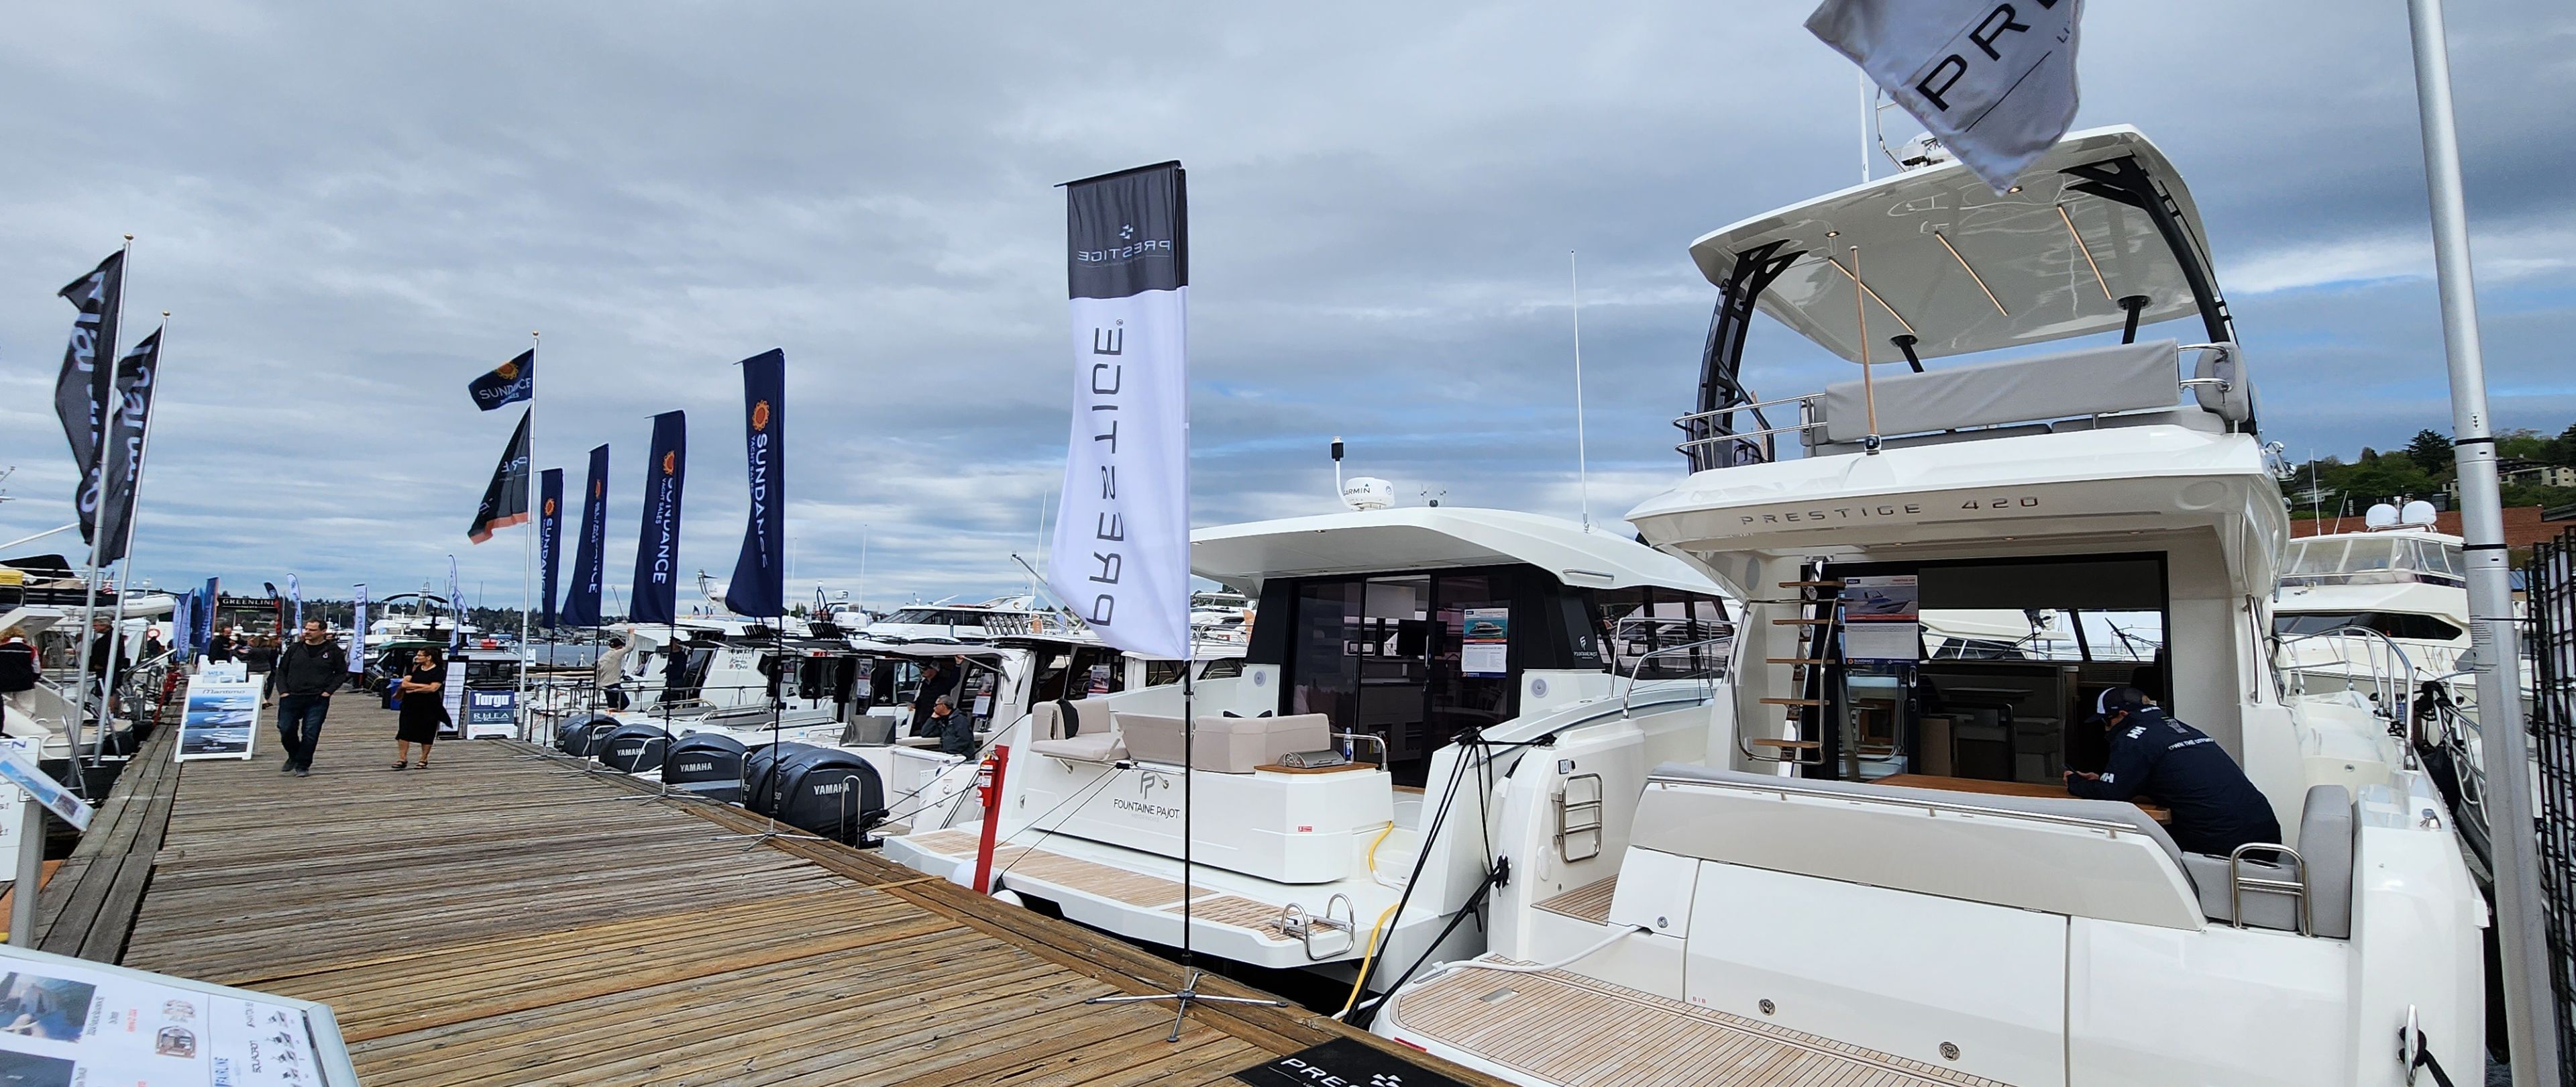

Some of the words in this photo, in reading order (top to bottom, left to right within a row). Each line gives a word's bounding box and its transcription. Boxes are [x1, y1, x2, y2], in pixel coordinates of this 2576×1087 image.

[1915, 0, 2058, 112] PR
[479, 378, 531, 399] SUNDCE
[659, 478, 667, 501] YACHT
[655, 502, 664, 525] SALES
[1740, 503, 1921, 525] PRESTIGE
[1961, 497, 2039, 511] 420
[616, 749, 646, 757] YAMAHA
[2167, 741, 2184, 751] OWN
[680, 762, 713, 773] YAMAHA
[813, 782, 850, 796] YAMAHA
[1114, 798, 1155, 815] FOUNTAINE
[1156, 806, 1181, 819] PAJOT
